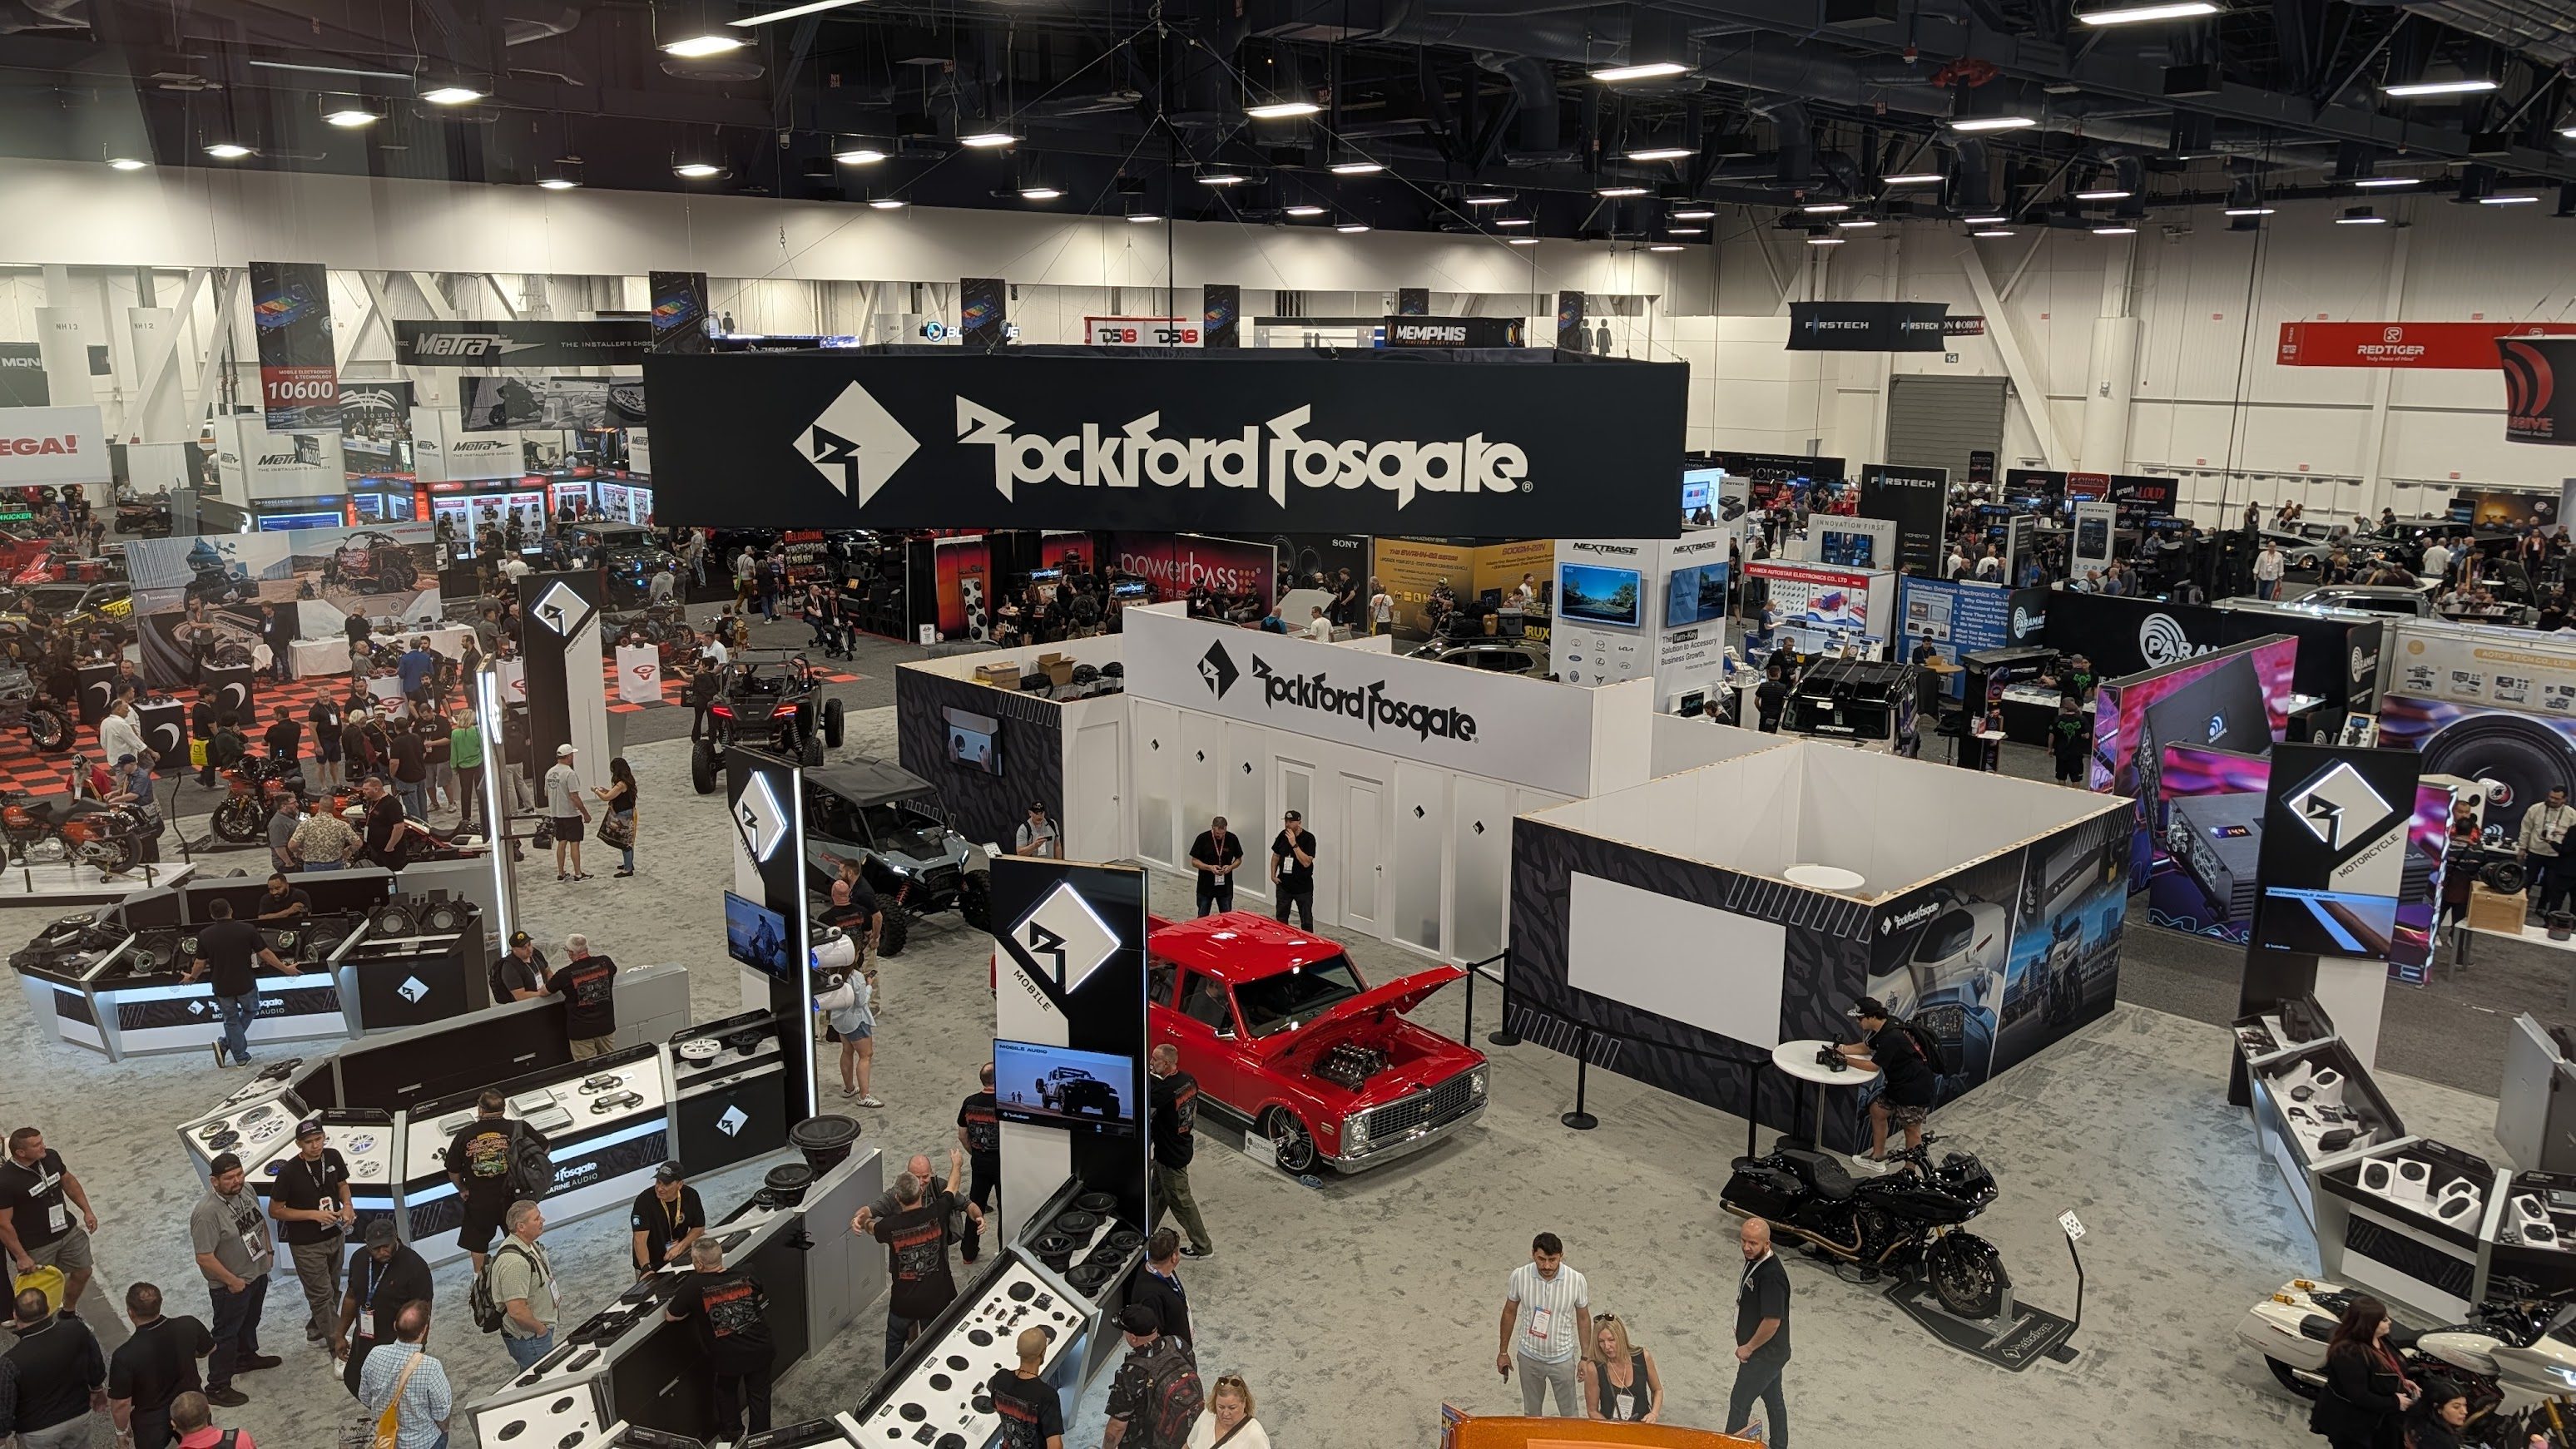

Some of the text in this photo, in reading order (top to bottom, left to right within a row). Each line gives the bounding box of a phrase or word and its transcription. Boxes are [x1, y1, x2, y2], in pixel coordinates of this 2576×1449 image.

[133, 322, 155, 330] NH12
[1805, 321, 1870, 329] FIRSTECH
[1900, 322, 1939, 330] FIRSTECH
[1098, 329, 1137, 343] DS18
[1153, 329, 1199, 344] DS18
[1396, 325, 1467, 341] MEMPHIS
[2356, 345, 2425, 355] REDTIGER
[268, 381, 334, 400] 10600
[0, 434, 78, 456] EGA!
[300, 447, 320, 464] 10600
[956, 394, 1528, 511] Rockford Fosgate
[1871, 476, 1936, 488] FIRSTECH
[1816, 519, 1861, 529] INNOVATION
[785, 531, 824, 542] DELUSIONAL
[1332, 538, 1359, 549] SONY
[1573, 542, 1639, 556] NEXTBASE
[1672, 541, 1717, 555] NEXTBASE
[1793, 571, 1826, 581] ELECTRONICS
[1907, 581, 1933, 591] Shenzhen
[1959, 589, 1990, 598] Electronics
[215, 619, 254, 636] DIAMOND
[579, 616, 598, 640] INSTALLED
[1673, 631, 1698, 641] Turn-Key
[1662, 645, 1683, 655] Solution
[1690, 638, 1717, 649] Accessory
[1661, 655, 1685, 665] Business
[2512, 654, 2534, 662] TECH
[1251, 653, 1477, 743] Rockford Fosgate
[740, 839, 759, 877] MARINE
[2337, 833, 2400, 878] MOTORCYCLE
[1013, 969, 1052, 1012] MOBILE
[259, 998, 284, 1008] sgate
[559, 1162, 597, 1182] Fosgate
[571, 1173, 598, 1186] AUDIO
[634, 1429, 656, 1438] SPEAKERS
[747, 1434, 774, 1445] SPEAKERS
